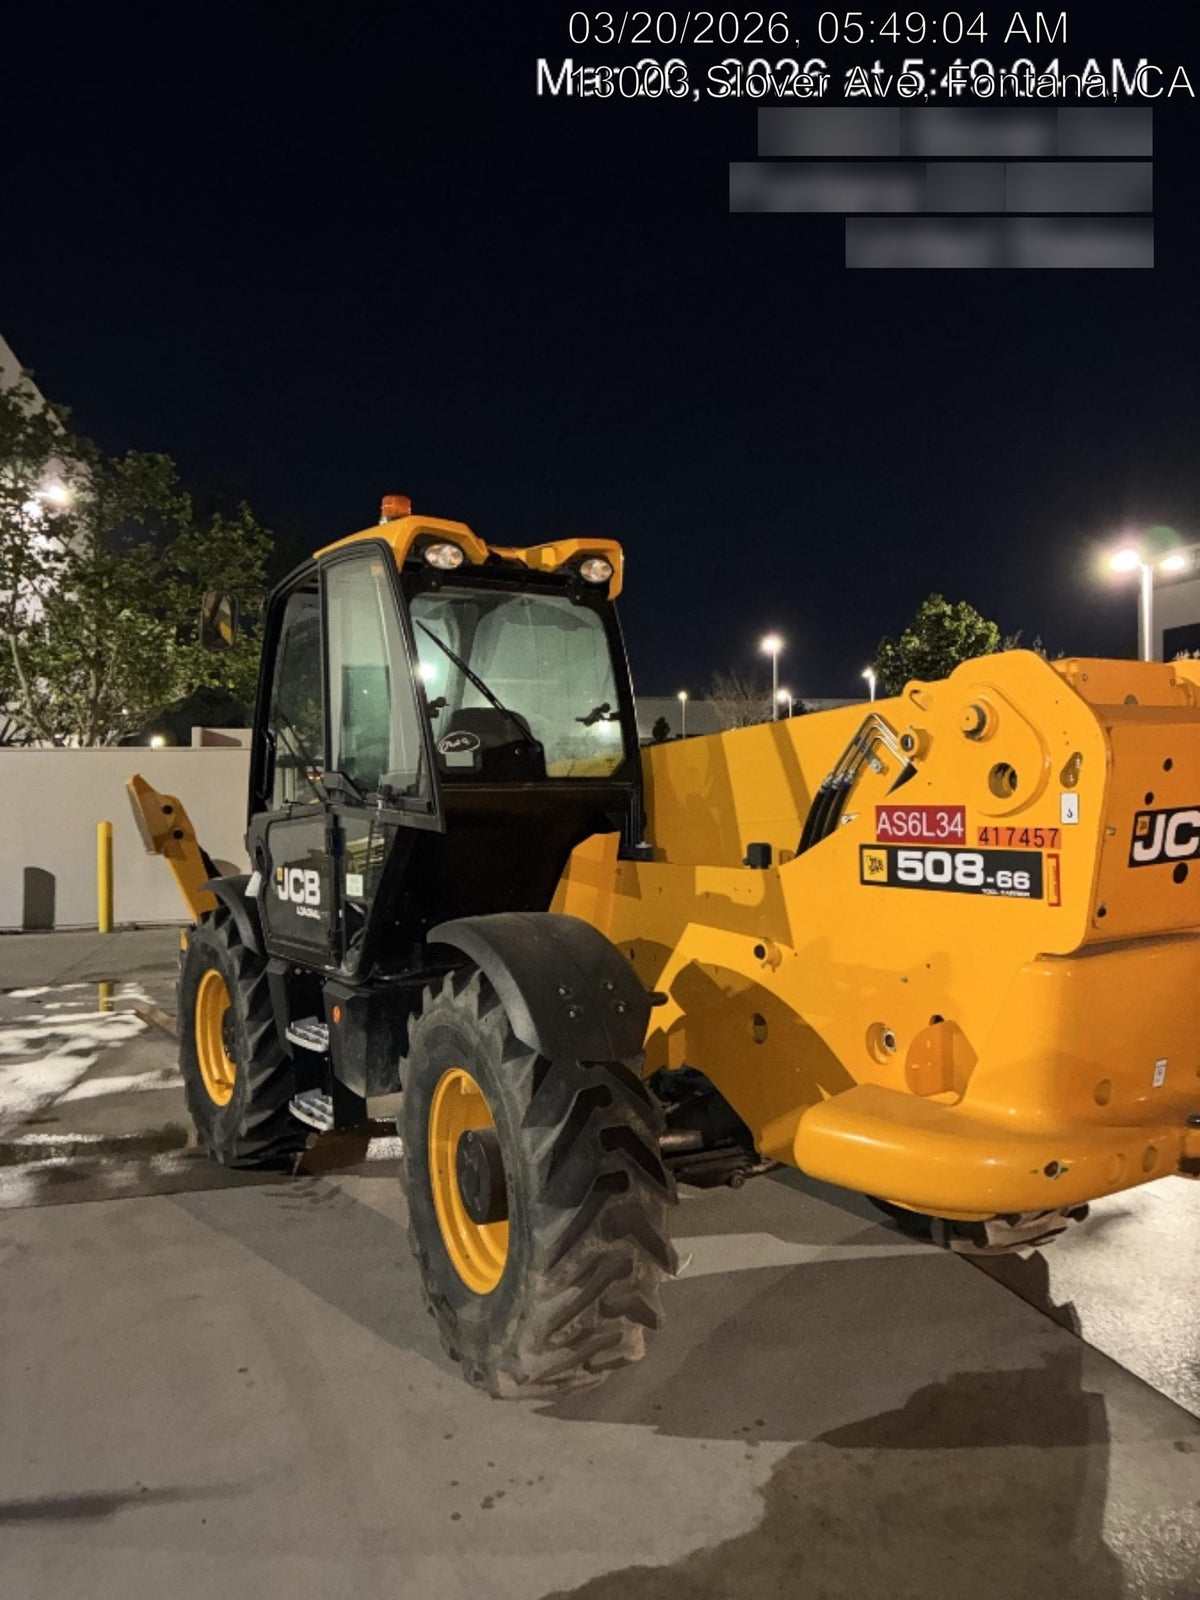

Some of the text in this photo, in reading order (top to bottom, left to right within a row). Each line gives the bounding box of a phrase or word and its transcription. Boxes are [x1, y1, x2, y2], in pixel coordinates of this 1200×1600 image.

[876, 811, 964, 838] AS6L34
[978, 826, 1060, 849] 417457
[276, 866, 321, 906] JCB
